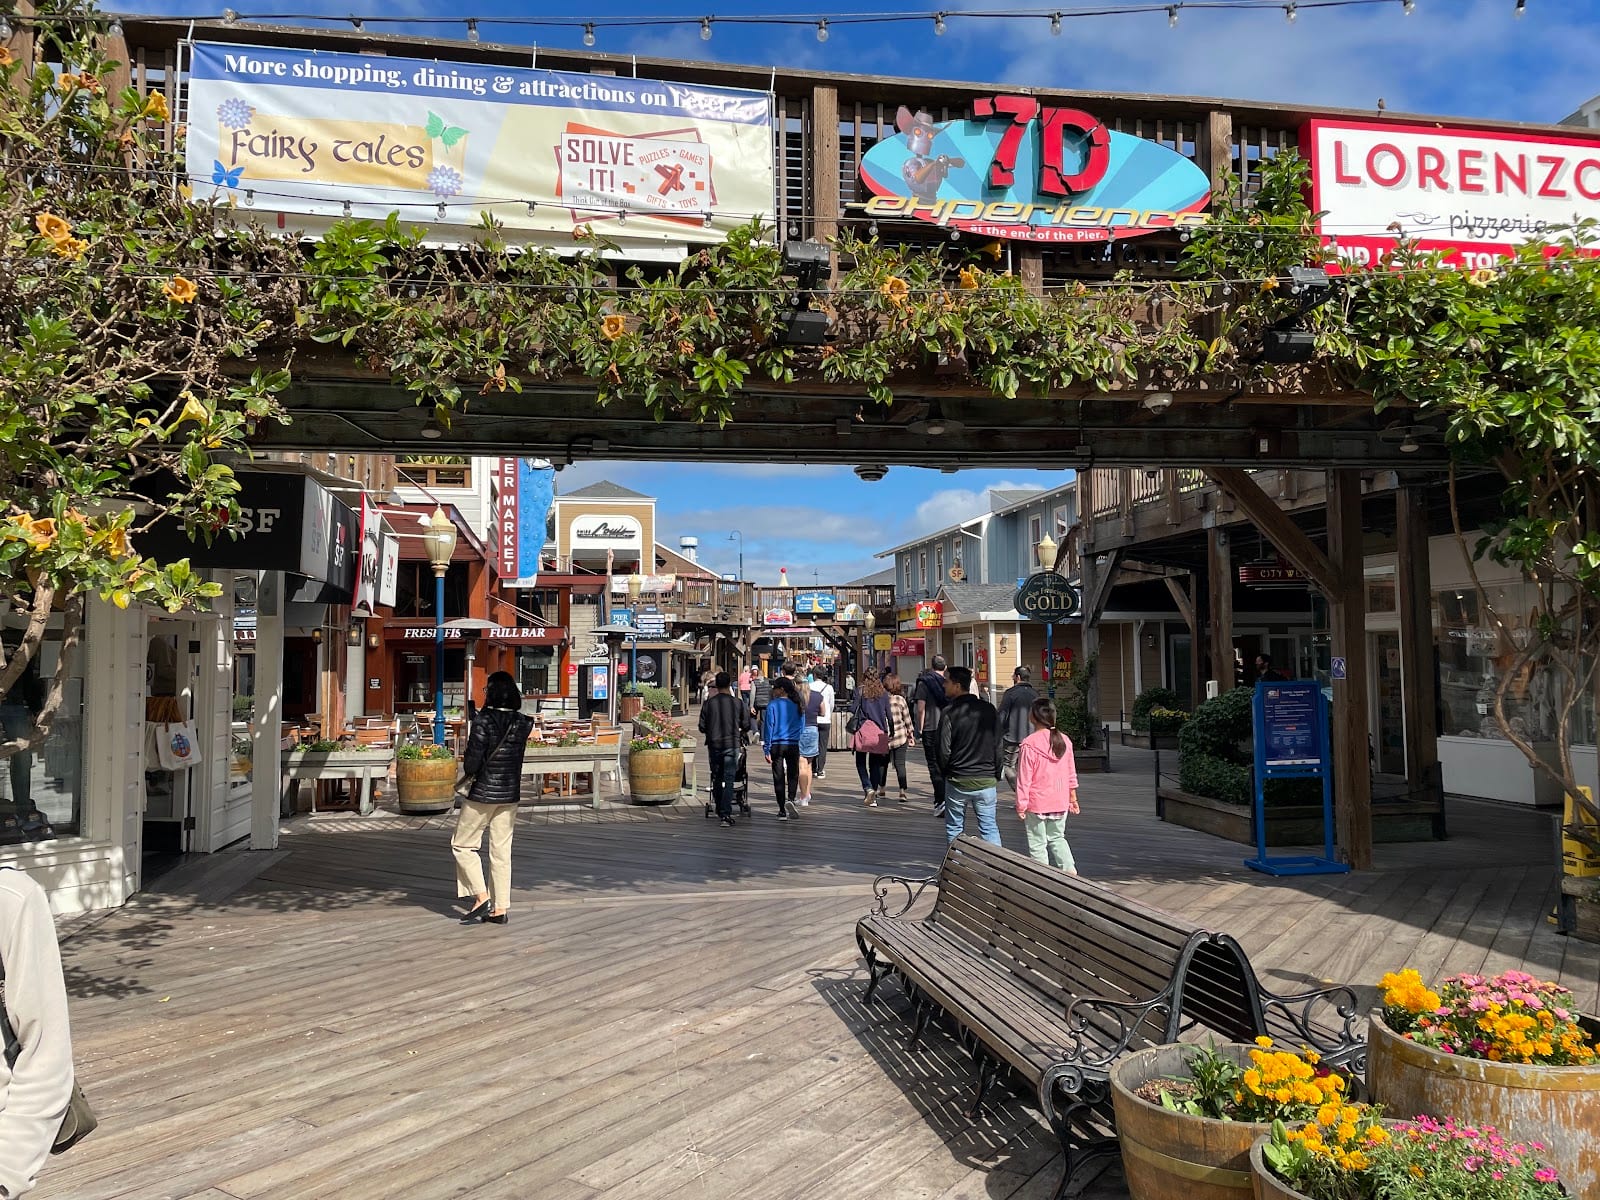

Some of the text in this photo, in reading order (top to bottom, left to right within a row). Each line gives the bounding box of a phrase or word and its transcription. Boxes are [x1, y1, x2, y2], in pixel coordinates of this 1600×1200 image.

[224, 54, 287, 76] More
[292, 58, 407, 87] shopping,
[413, 67, 487, 95] dining
[492, 75, 514, 94] &
[519, 79, 635, 105] attractions
[641, 92, 667, 107] on
[567, 139, 635, 166] SOLVE
[973, 95, 1111, 197] 7D
[639, 148, 704, 166] PUZZLES GAMES
[589, 168, 614, 192] IT!
[608, 198, 617, 206] the
[620, 199, 631, 208] Box
[646, 194, 698, 209] GIFTS TOYS
[1449, 209, 1554, 240] pizzeria
[987, 226, 1006, 237] the
[1037, 230, 1050, 240] of
[1054, 231, 1073, 240] the
[1077, 231, 1104, 240] Pier.
[503, 495, 515, 572] MARKET
[951, 569, 962, 578] SF
[1260, 569, 1282, 578] CITY
[1024, 595, 1072, 610] GOLD
[444, 628, 461, 638] FIS
[489, 628, 519, 638] FULL
[521, 628, 545, 638] BAR
